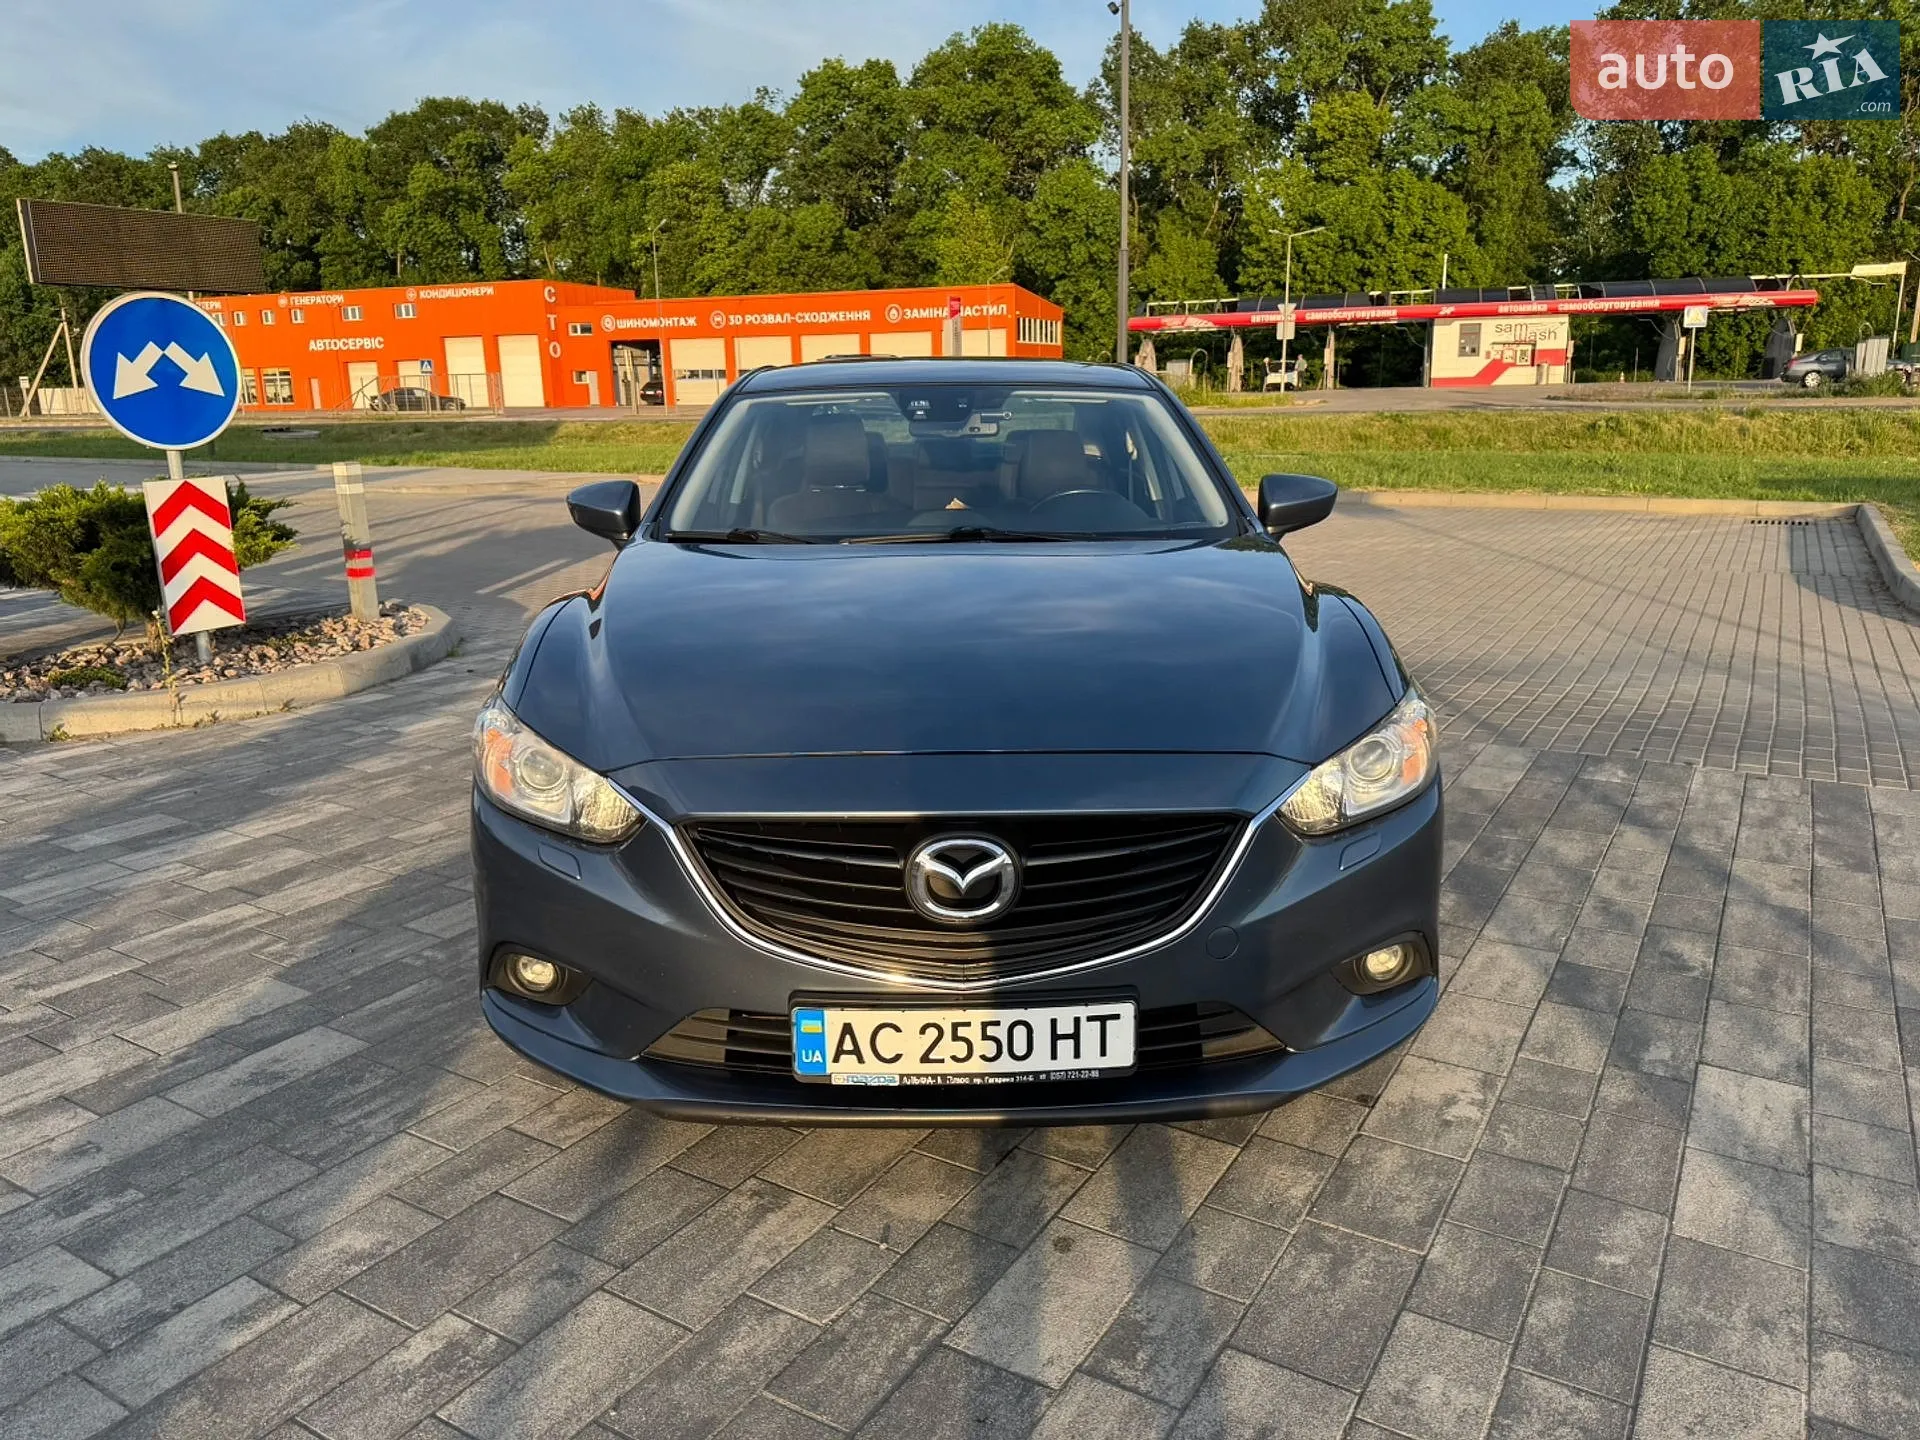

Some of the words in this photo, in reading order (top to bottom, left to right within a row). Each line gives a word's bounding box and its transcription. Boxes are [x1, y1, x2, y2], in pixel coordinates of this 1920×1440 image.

[289, 294, 345, 306] ГЕНЕРАТОРИ
[616, 316, 698, 329] ШИНОМОНТАЖ
[728, 314, 742, 326] 3D
[745, 309, 871, 325] РОЗВАЛ-СХОДЖЕННЯ
[308, 335, 385, 352] АВТОСЕРВІС
[831, 1021, 904, 1065] AC
[917, 1018, 1035, 1064] 2550
[1048, 1012, 1122, 1062] HT
[801, 1050, 824, 1064] UA
